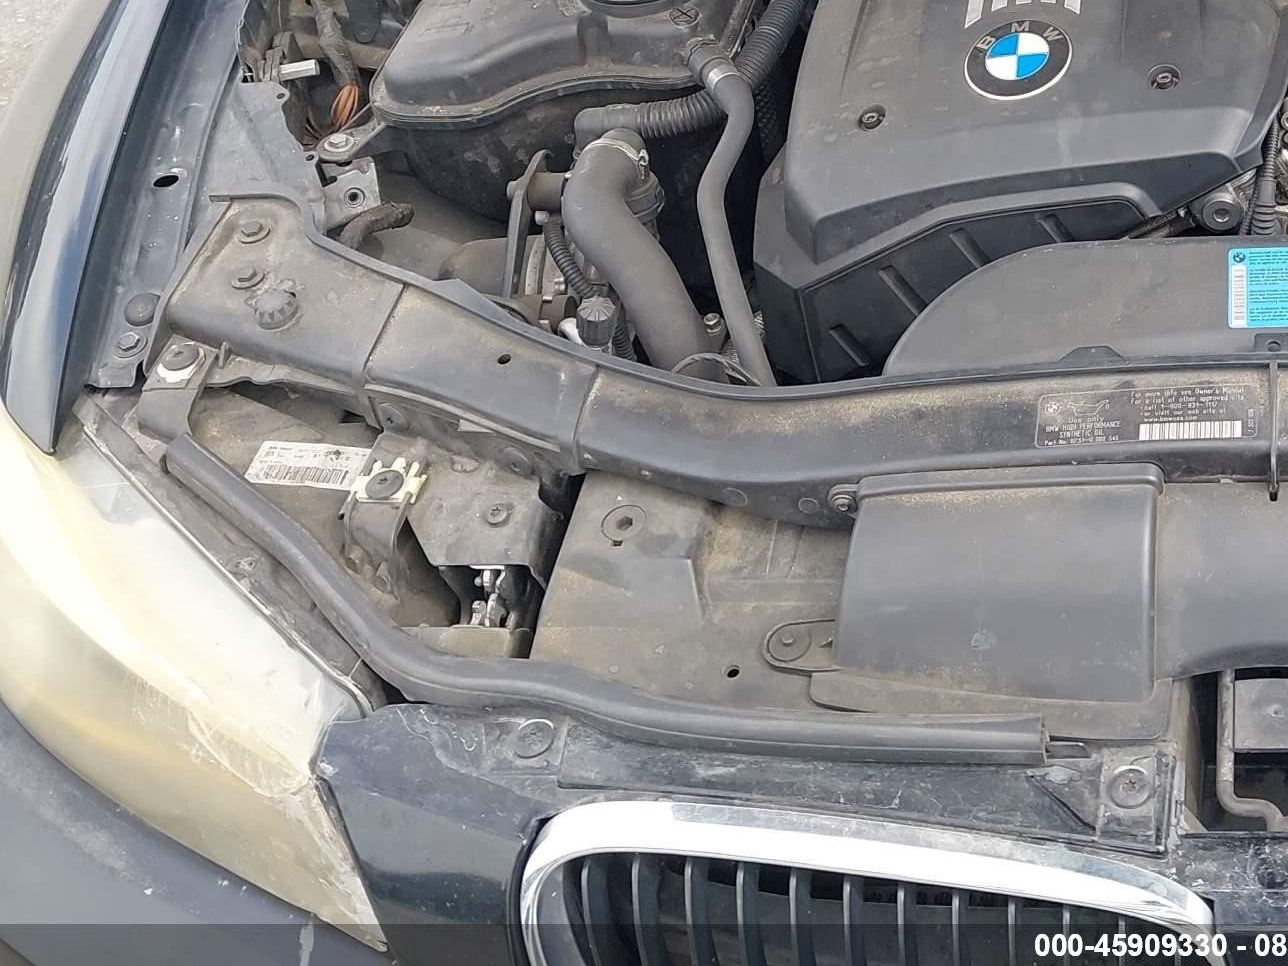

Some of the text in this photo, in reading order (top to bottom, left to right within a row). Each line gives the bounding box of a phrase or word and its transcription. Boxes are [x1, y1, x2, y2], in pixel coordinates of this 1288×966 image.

[976, 20, 1064, 51] BMW
[1200, 394, 1228, 402] approved
[1080, 421, 1121, 430] PERFORMANCE
[1059, 429, 1091, 438] SYNTHETIC
